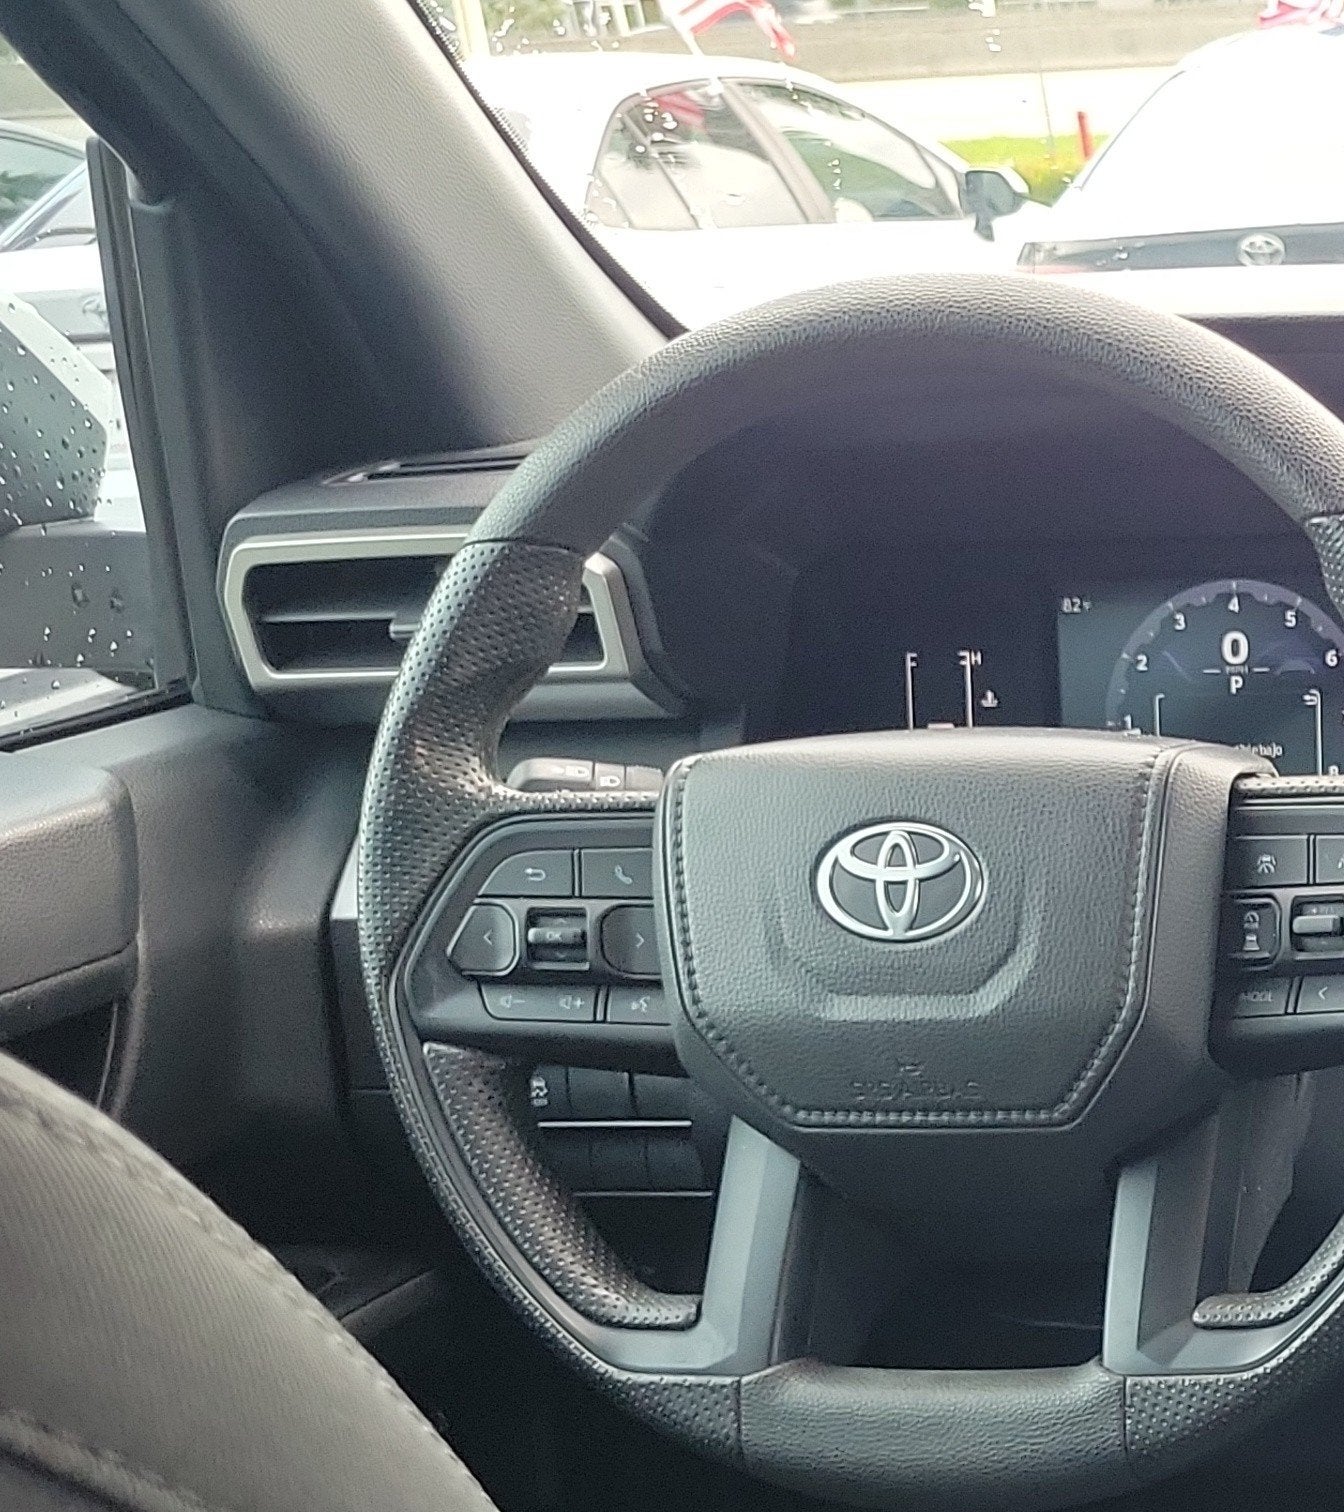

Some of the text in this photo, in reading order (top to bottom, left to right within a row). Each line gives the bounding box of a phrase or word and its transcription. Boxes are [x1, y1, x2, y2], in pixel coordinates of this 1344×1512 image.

[1227, 596, 1240, 613] 4
[1174, 613, 1186, 630] 3
[1284, 610, 1297, 627] 5
[1221, 630, 1249, 665] 0
[1136, 655, 1148, 671] 2
[1324, 650, 1339, 667] 6
[1230, 675, 1243, 694] P
